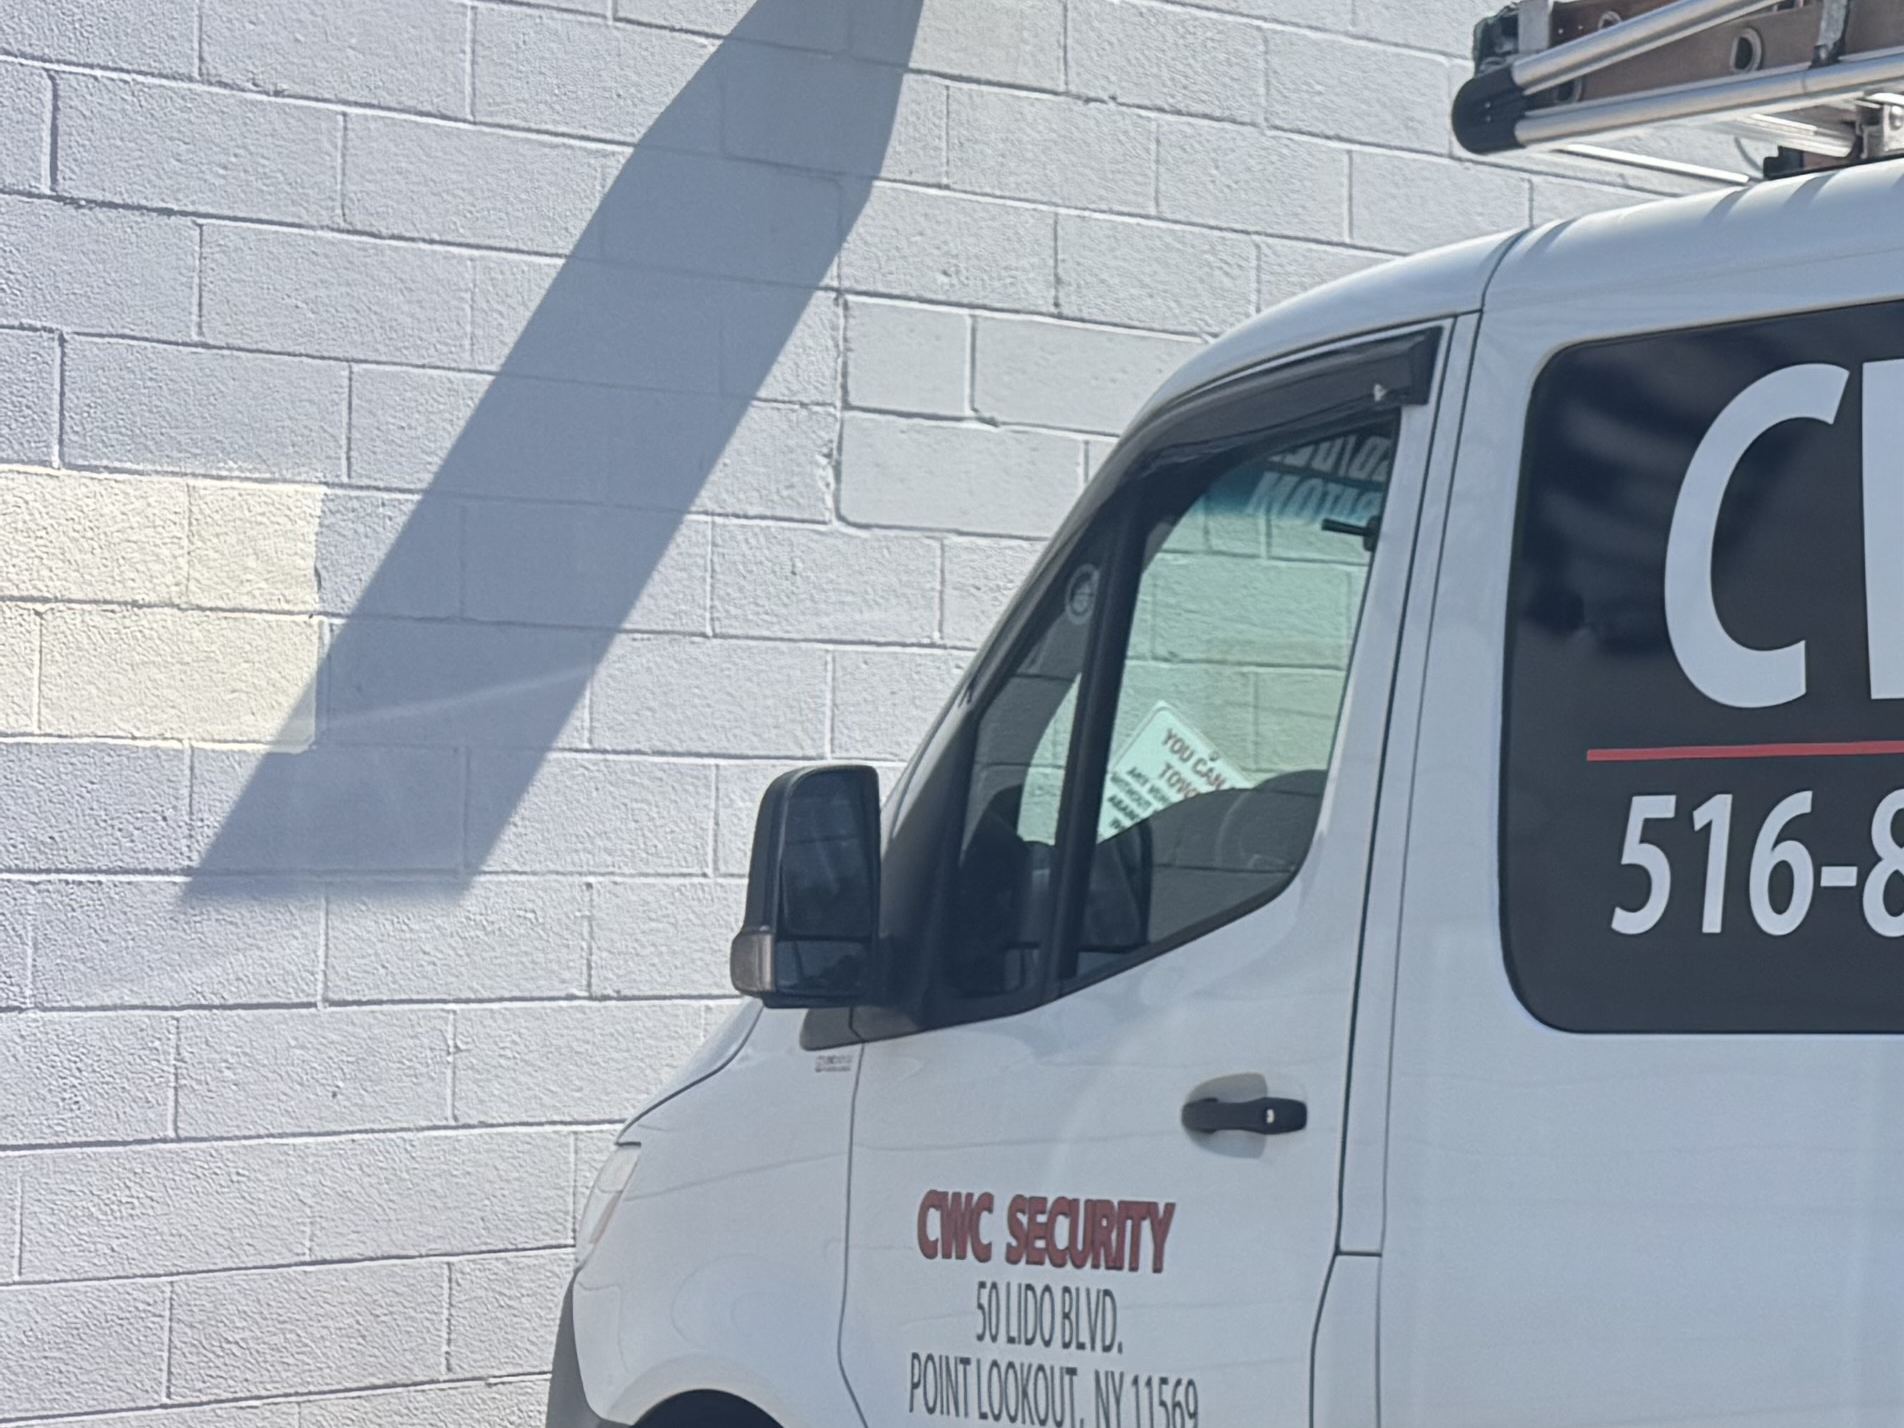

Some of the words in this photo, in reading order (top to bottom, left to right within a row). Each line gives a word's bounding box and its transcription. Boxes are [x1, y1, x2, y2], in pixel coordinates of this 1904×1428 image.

[1161, 727, 1195, 764] YOU
[917, 1189, 994, 1263] CWC
[1005, 1194, 1176, 1273] SECURITY
[976, 1280, 999, 1343] 50
[1006, 1281, 1055, 1348] LIDO
[1061, 1285, 1123, 1355] BLVD.
[909, 1351, 971, 1420] POINT
